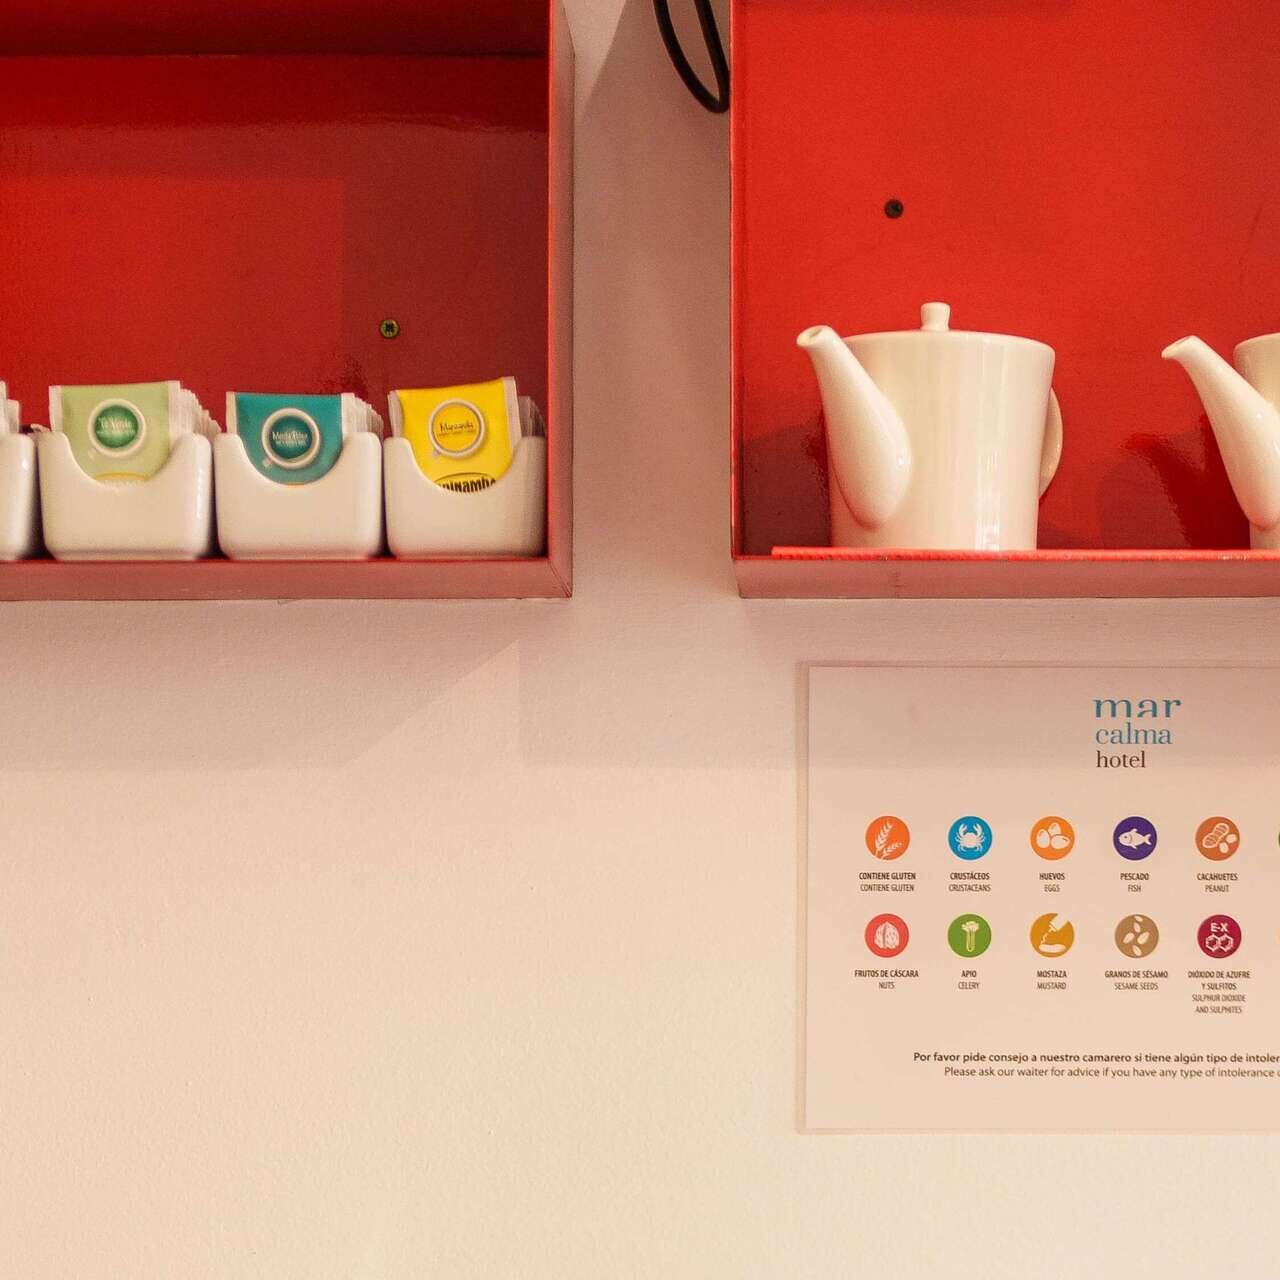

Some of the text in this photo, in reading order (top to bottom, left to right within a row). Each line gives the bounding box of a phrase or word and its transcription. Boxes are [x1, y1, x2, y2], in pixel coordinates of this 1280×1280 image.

[1092, 699, 1181, 718] mar
[1095, 722, 1173, 745] calma
[1096, 750, 1146, 768] hotel
[858, 872, 917, 881] CONTIENE GLUTEN
[950, 870, 991, 881] CRUSTÁCEOS
[1039, 872, 1066, 881] HUEVOS
[1120, 872, 1150, 881] PESCADO
[1197, 872, 1239, 881] CACAHUETES
[860, 884, 915, 893] CONTIENE GLUTEN
[948, 884, 992, 893] CRUSTACEANS
[1044, 884, 1061, 893] EGGS
[1127, 884, 1142, 893] FISH
[1205, 884, 1230, 893] PEANUT
[854, 968, 919, 979] FRUTOS DE CÁSCARA
[961, 969, 977, 979] APIO
[1037, 969, 1067, 979] MOSTAZA
[1104, 969, 1169, 978] GRANOS DE SÉSAMO
[1188, 969, 1252, 979] DIÓXIDO DE AZUFRE
[878, 981, 896, 990] NUTS
[958, 981, 980, 991] CELERY
[1036, 981, 1067, 991] MUSTARD
[1113, 982, 1159, 991] SESAME SEEDS
[1207, 982, 1237, 991] SULFITOS
[913, 1052, 931, 1062] Por
[933, 1052, 960, 1062] favor
[963, 1052, 986, 1064] pide
[988, 1053, 1029, 1064] consejo
[1040, 1054, 1080, 1062] nuestro
[1082, 1055, 1132, 1063] camarero
[1134, 1053, 1142, 1063] si
[1145, 1053, 1171, 1063] tiene
[1173, 1052, 1204, 1065] algún
[1206, 1053, 1228, 1065] tipo
[1230, 1053, 1243, 1063] de
[944, 1067, 976, 1077] Please
[978, 1067, 995, 1077] ask
[998, 1069, 1014, 1077] our
[1016, 1067, 1048, 1077] waiter
[1050, 1067, 1065, 1077] for
[1067, 1067, 1100, 1077] advice
[1102, 1067, 1109, 1077] if
[1111, 1069, 1130, 1079] you
[1132, 1067, 1157, 1077] have
[1159, 1070, 1176, 1079] any
[1179, 1069, 1203, 1079] type
[1205, 1067, 1216, 1077] of
[1218, 1067, 1275, 1078] intolerance
